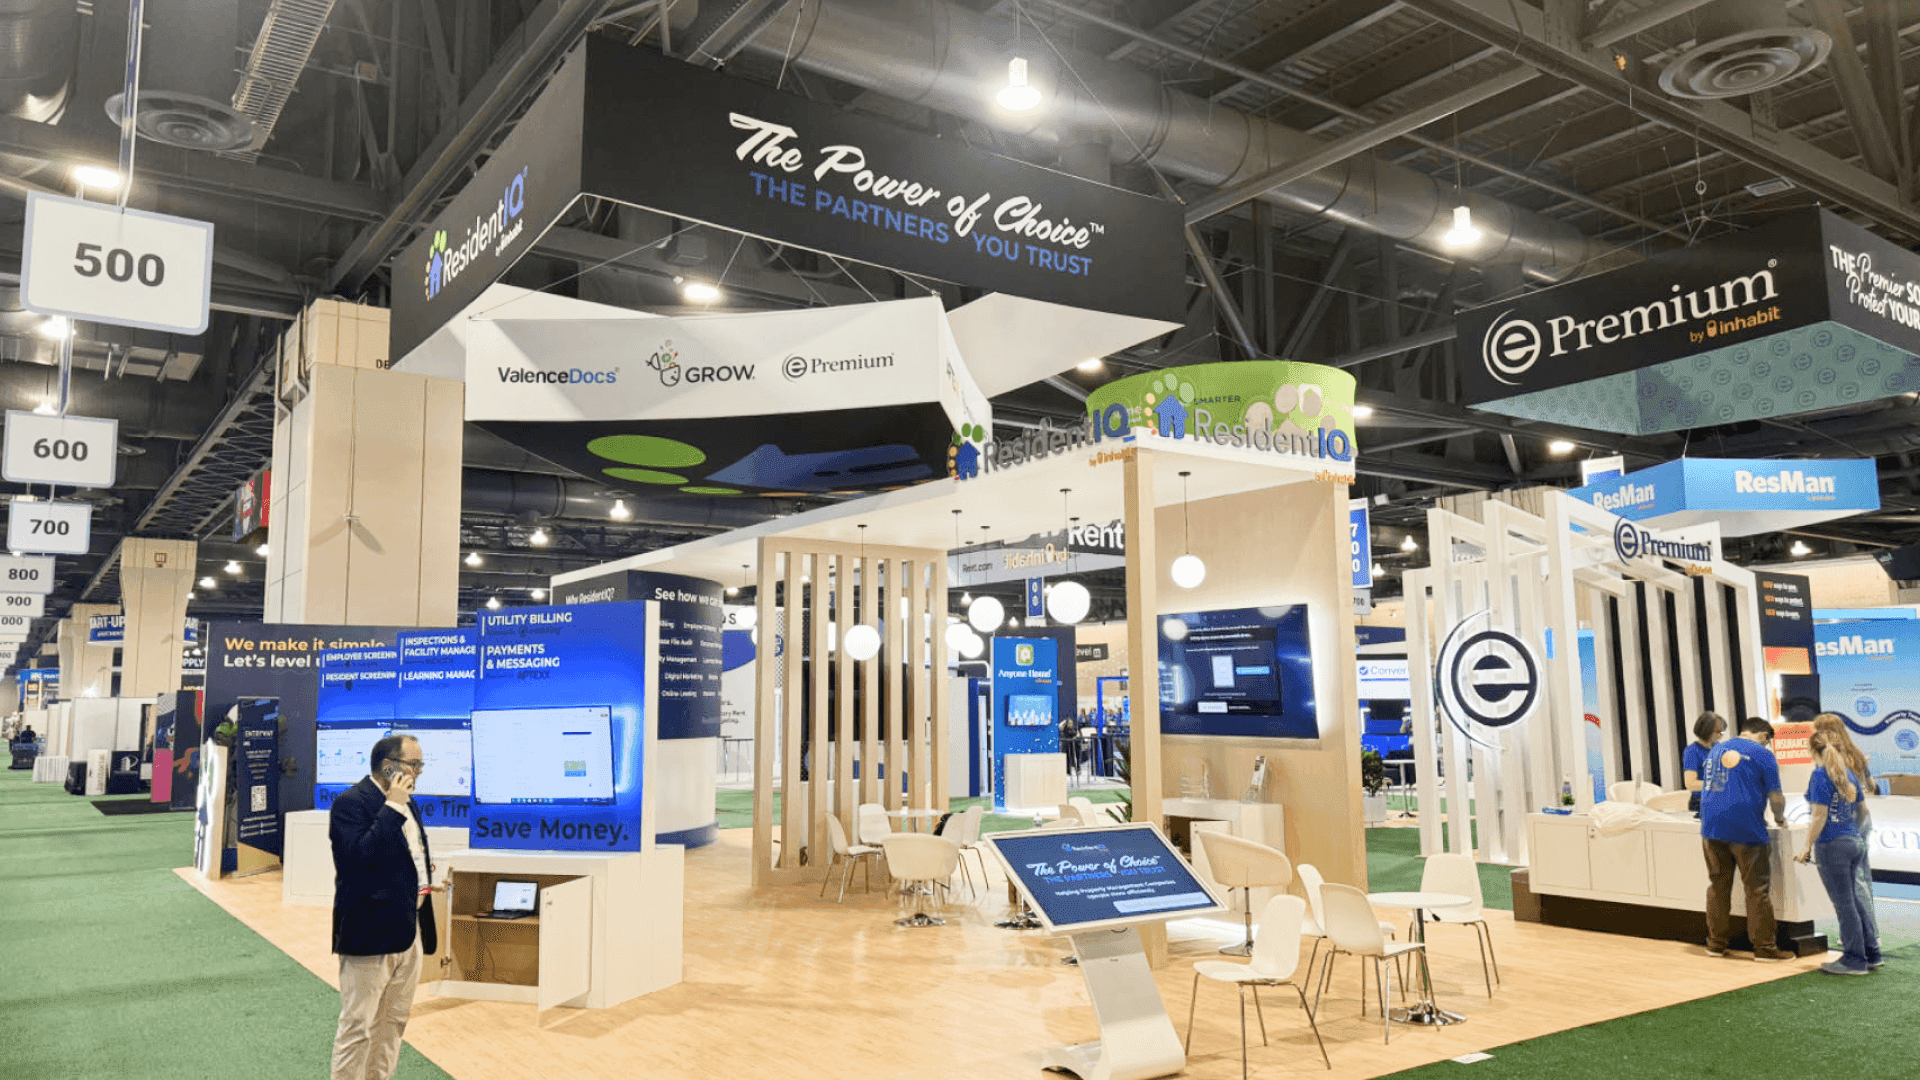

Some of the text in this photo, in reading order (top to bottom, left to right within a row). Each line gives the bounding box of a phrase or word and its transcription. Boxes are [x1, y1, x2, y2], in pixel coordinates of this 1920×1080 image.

[729, 112, 803, 173] The
[814, 145, 940, 207] Power
[948, 192, 991, 237] of
[750, 171, 1093, 276] THE PARTNERS YOU TRUST
[73, 242, 165, 287] 500
[1830, 244, 1856, 274] THE
[1856, 252, 1904, 297] Premier
[1846, 274, 1888, 318] Protect
[1719, 306, 1781, 336] inhabit
[811, 353, 894, 374] Premium
[497, 366, 618, 385] ValenceDocs
[984, 402, 1131, 474] ResidentIQ
[1193, 407, 1352, 462] ResidentIQ
[33, 437, 89, 461] 600
[1735, 470, 1835, 494] ResMan
[1593, 483, 1656, 511] ResMan
[29, 518, 70, 536] 700
[1640, 530, 1712, 562] Premium
[8, 568, 39, 581] 800
[6, 596, 32, 607] 900
[655, 587, 675, 600] See
[678, 588, 697, 602] how
[487, 612, 573, 627] UTILITY BILLING
[225, 637, 255, 651] We
[260, 637, 309, 651] make
[312, 636, 324, 652] it
[405, 635, 458, 646] INSPECTIONS
[486, 644, 545, 656] PAYMENTS
[224, 653, 311, 668] Let's level
[326, 652, 362, 662] EMPLOYEE
[404, 647, 438, 657] FACILITY
[486, 657, 560, 670] & MESSAGING
[404, 671, 444, 681] LEARNING
[475, 817, 629, 847] Save Money.
[1026, 861, 1055, 876] The
[1056, 860, 1099, 874] Power
[1103, 858, 1117, 874] of
